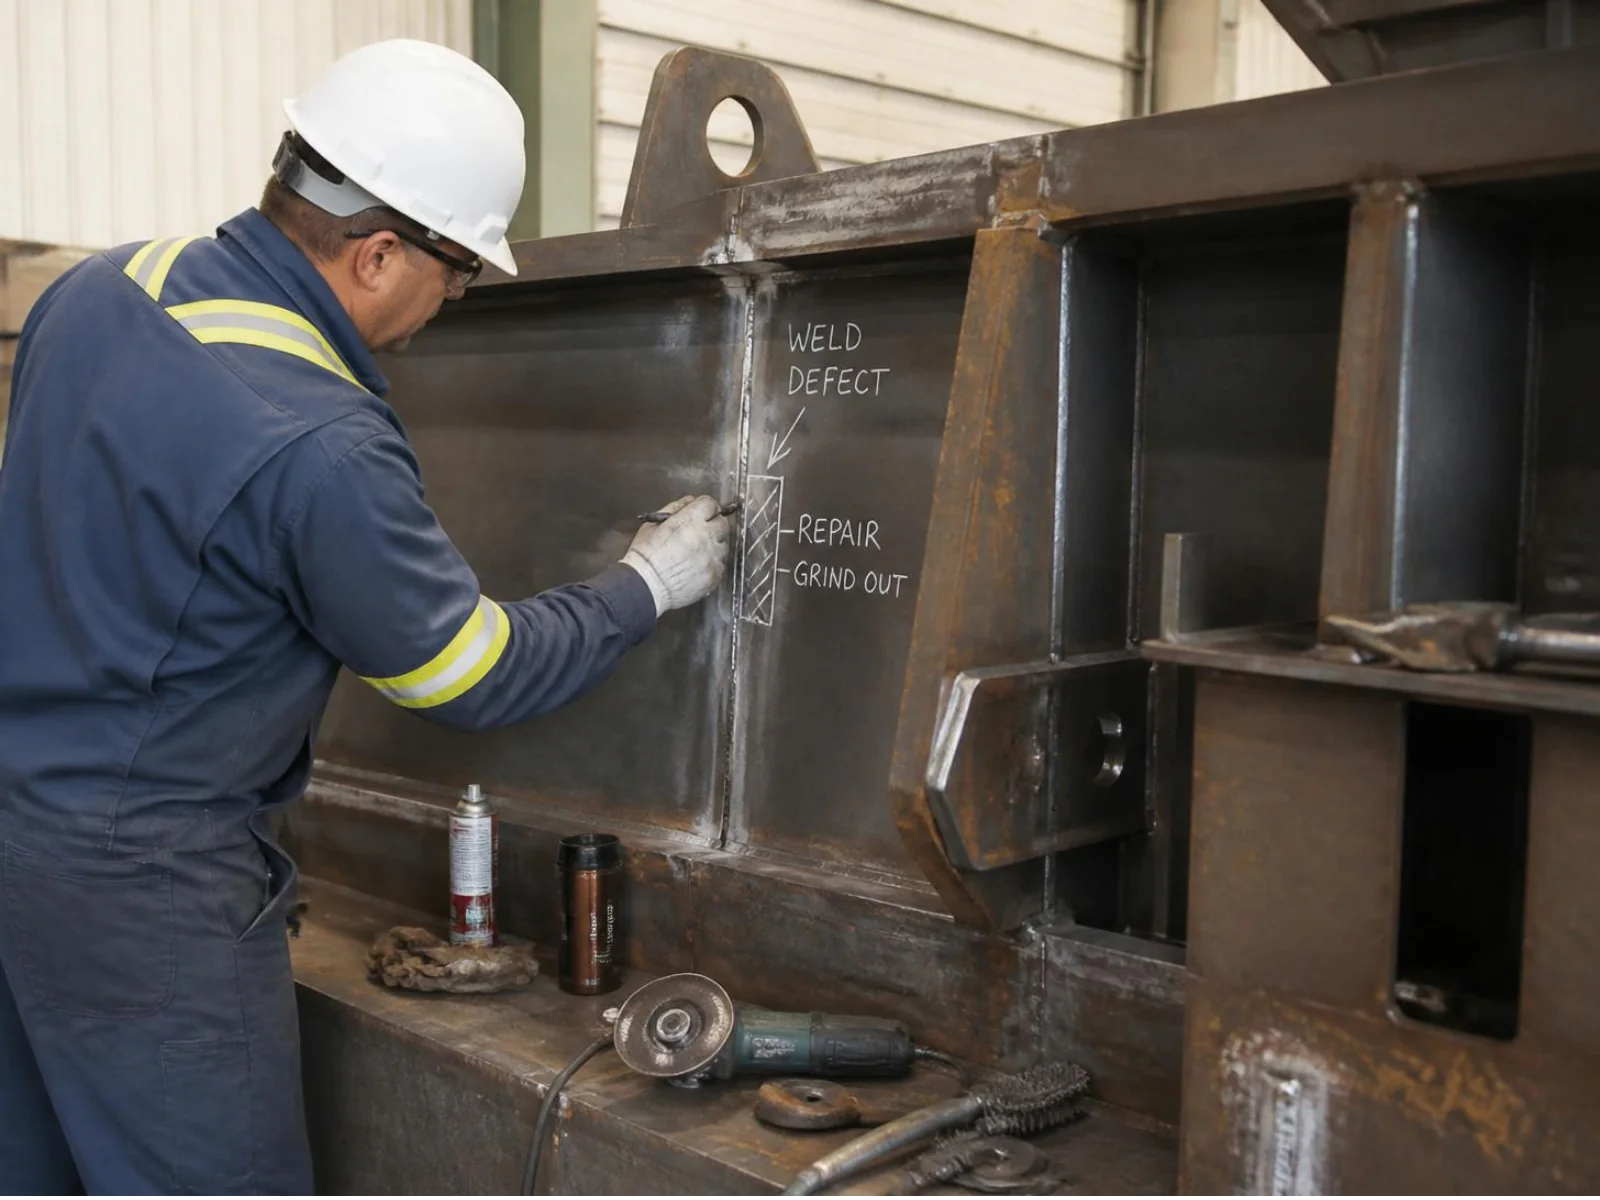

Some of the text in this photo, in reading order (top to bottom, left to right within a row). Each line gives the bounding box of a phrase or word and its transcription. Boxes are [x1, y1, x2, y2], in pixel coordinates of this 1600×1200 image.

[788, 322, 862, 352] WELD
[788, 366, 890, 396] DEFECT
[798, 513, 881, 550] REPAIR
[793, 561, 908, 598] GRIND OUT
